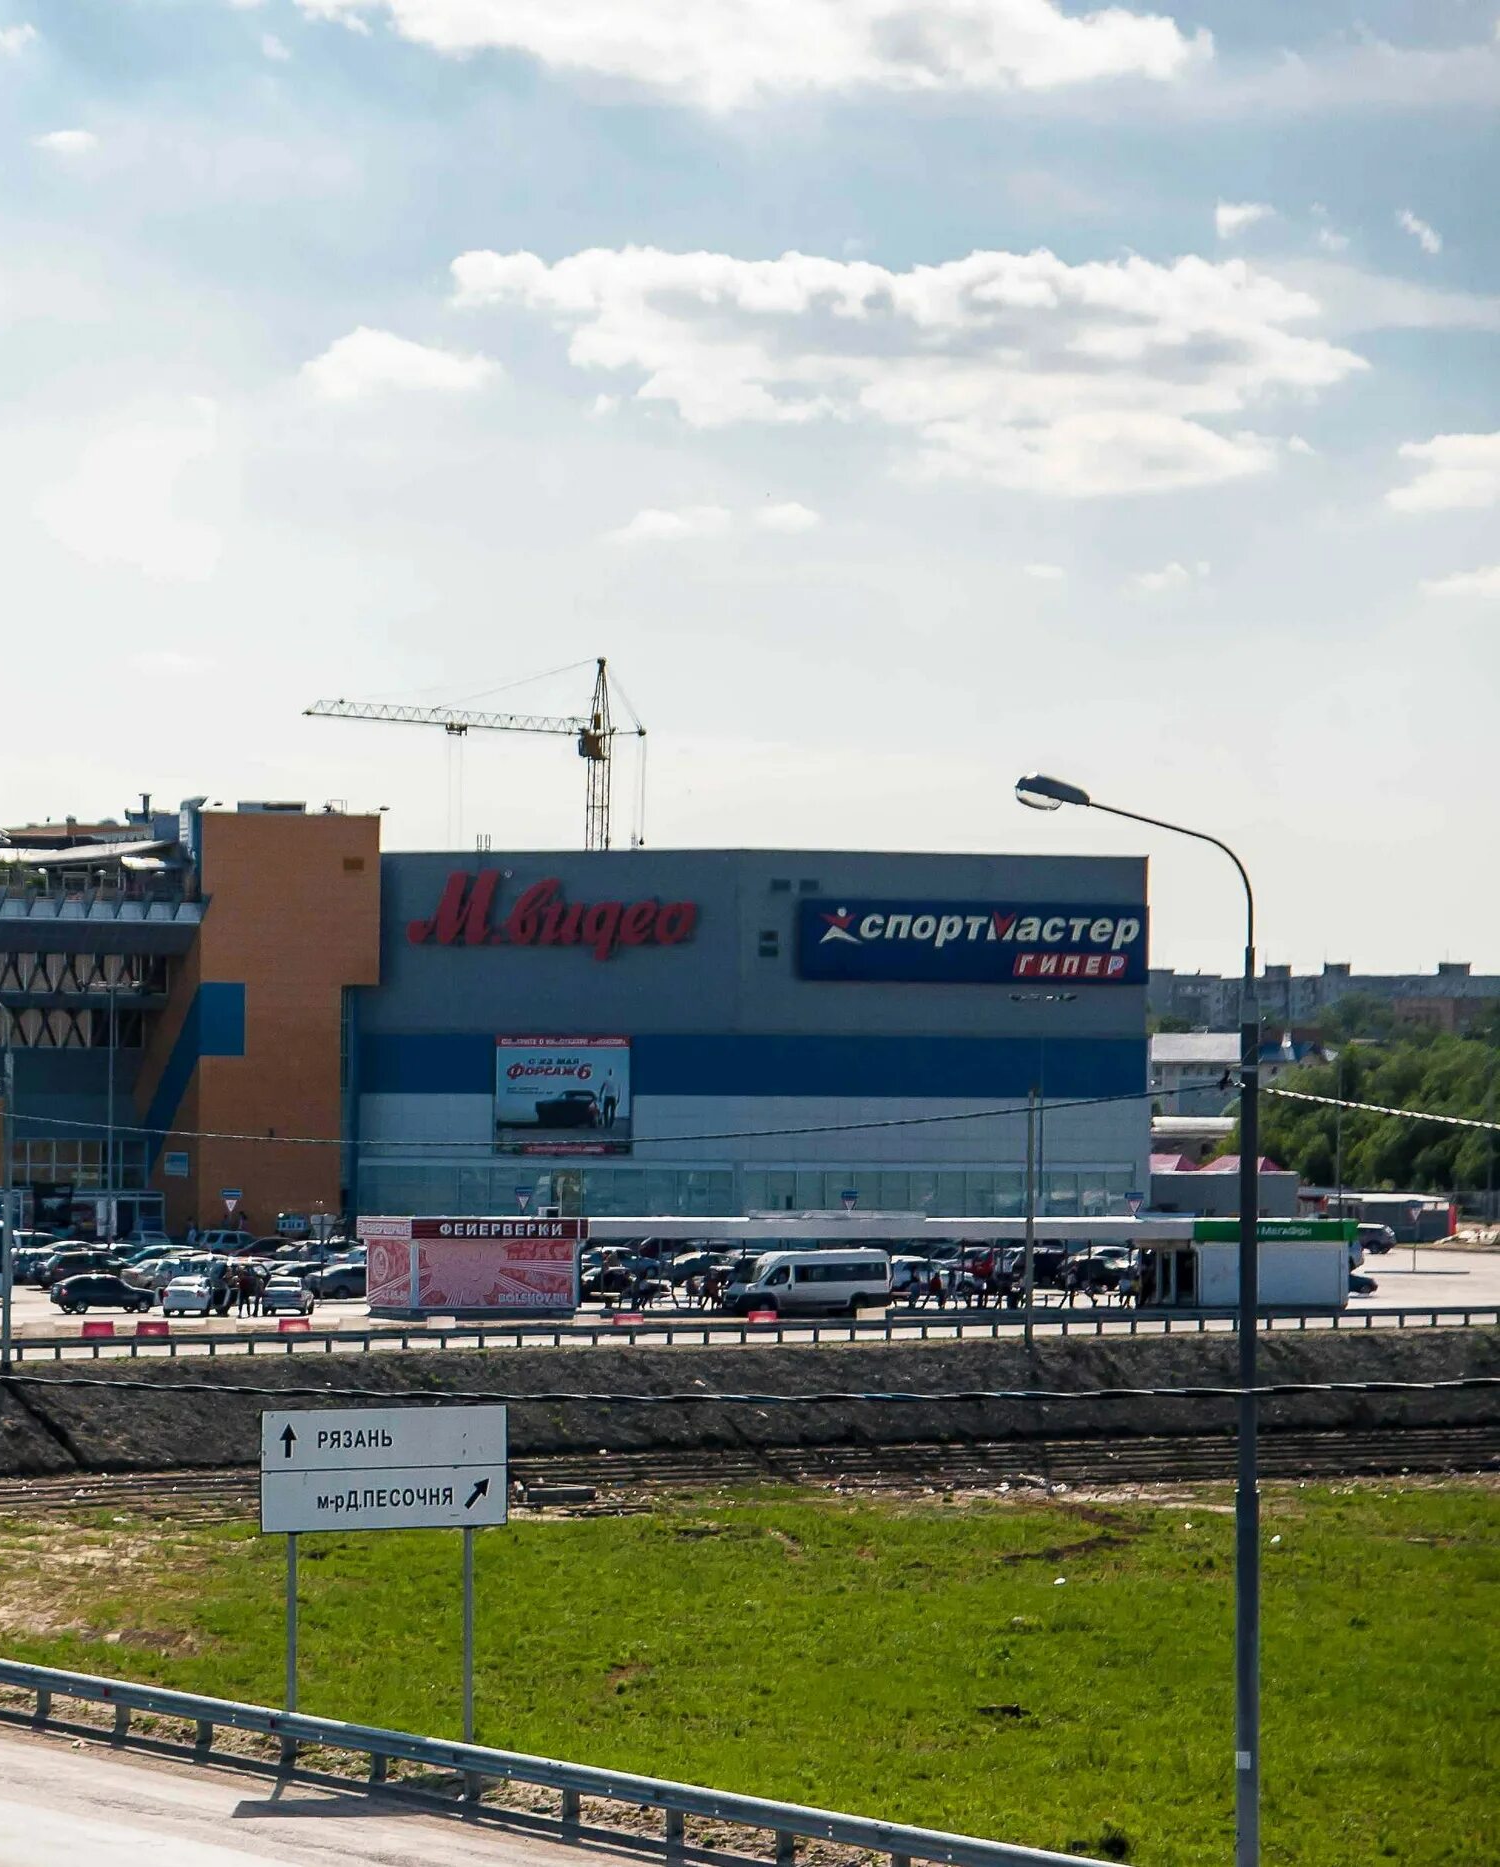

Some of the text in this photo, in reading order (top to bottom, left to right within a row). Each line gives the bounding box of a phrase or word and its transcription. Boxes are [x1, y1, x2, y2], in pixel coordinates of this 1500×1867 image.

[1017, 954, 1126, 976] ГИПЕР
[439, 1218, 563, 1236] ФЕЙЕРВЕРКИ
[317, 1429, 393, 1449] РЯЗАНЬ
